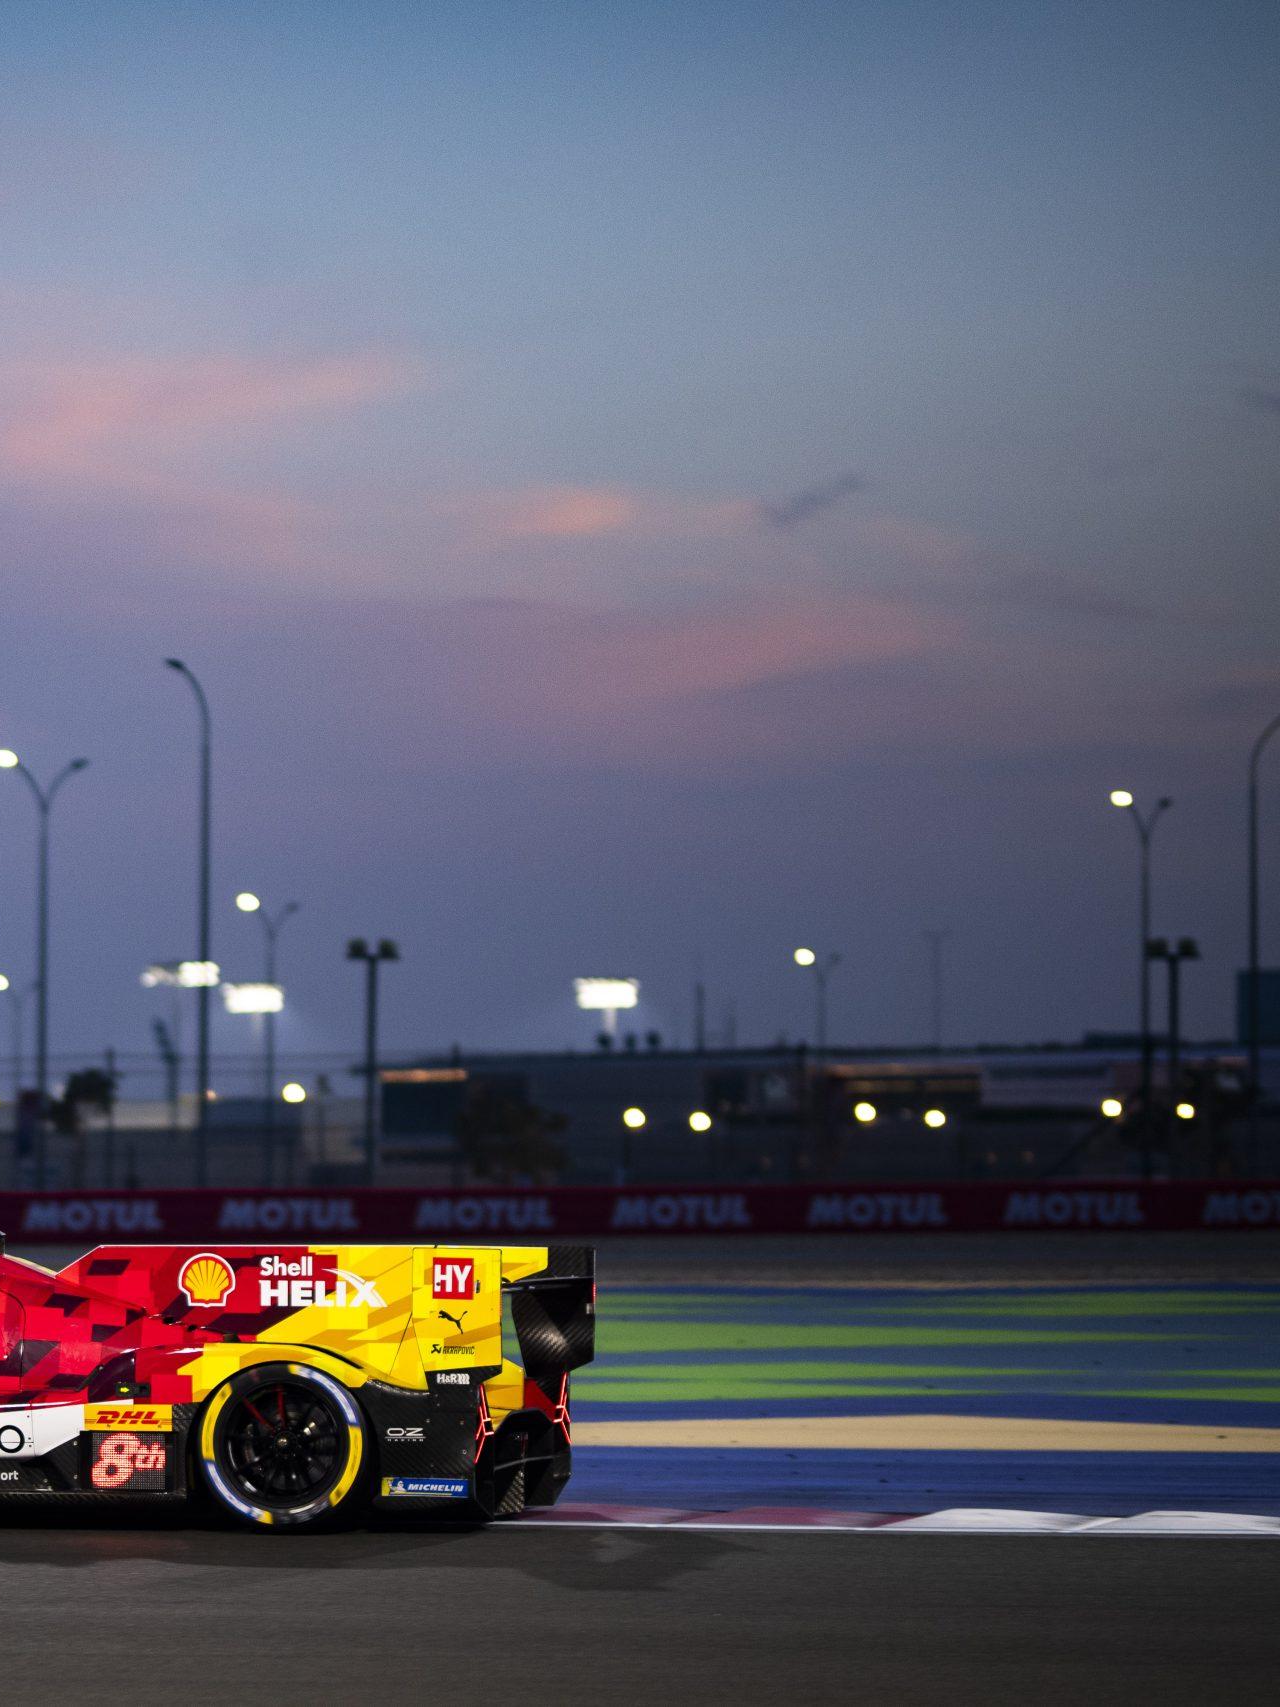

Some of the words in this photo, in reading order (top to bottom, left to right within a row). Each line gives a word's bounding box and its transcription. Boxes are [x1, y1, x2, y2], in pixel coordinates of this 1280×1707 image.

[22, 1200, 163, 1232] MOTUL
[217, 1199, 359, 1231] MOTUL
[414, 1198, 556, 1229] MOTUL
[610, 1195, 752, 1228] MOTUL
[807, 1193, 949, 1226] MOTUL
[1004, 1192, 1145, 1224] MOTUL
[259, 1255, 313, 1277] Shell
[433, 1264, 472, 1293] HY
[258, 1277, 387, 1308] HELIX
[96, 1410, 160, 1425] DHL
[407, 1483, 464, 1493] MICHELIN
